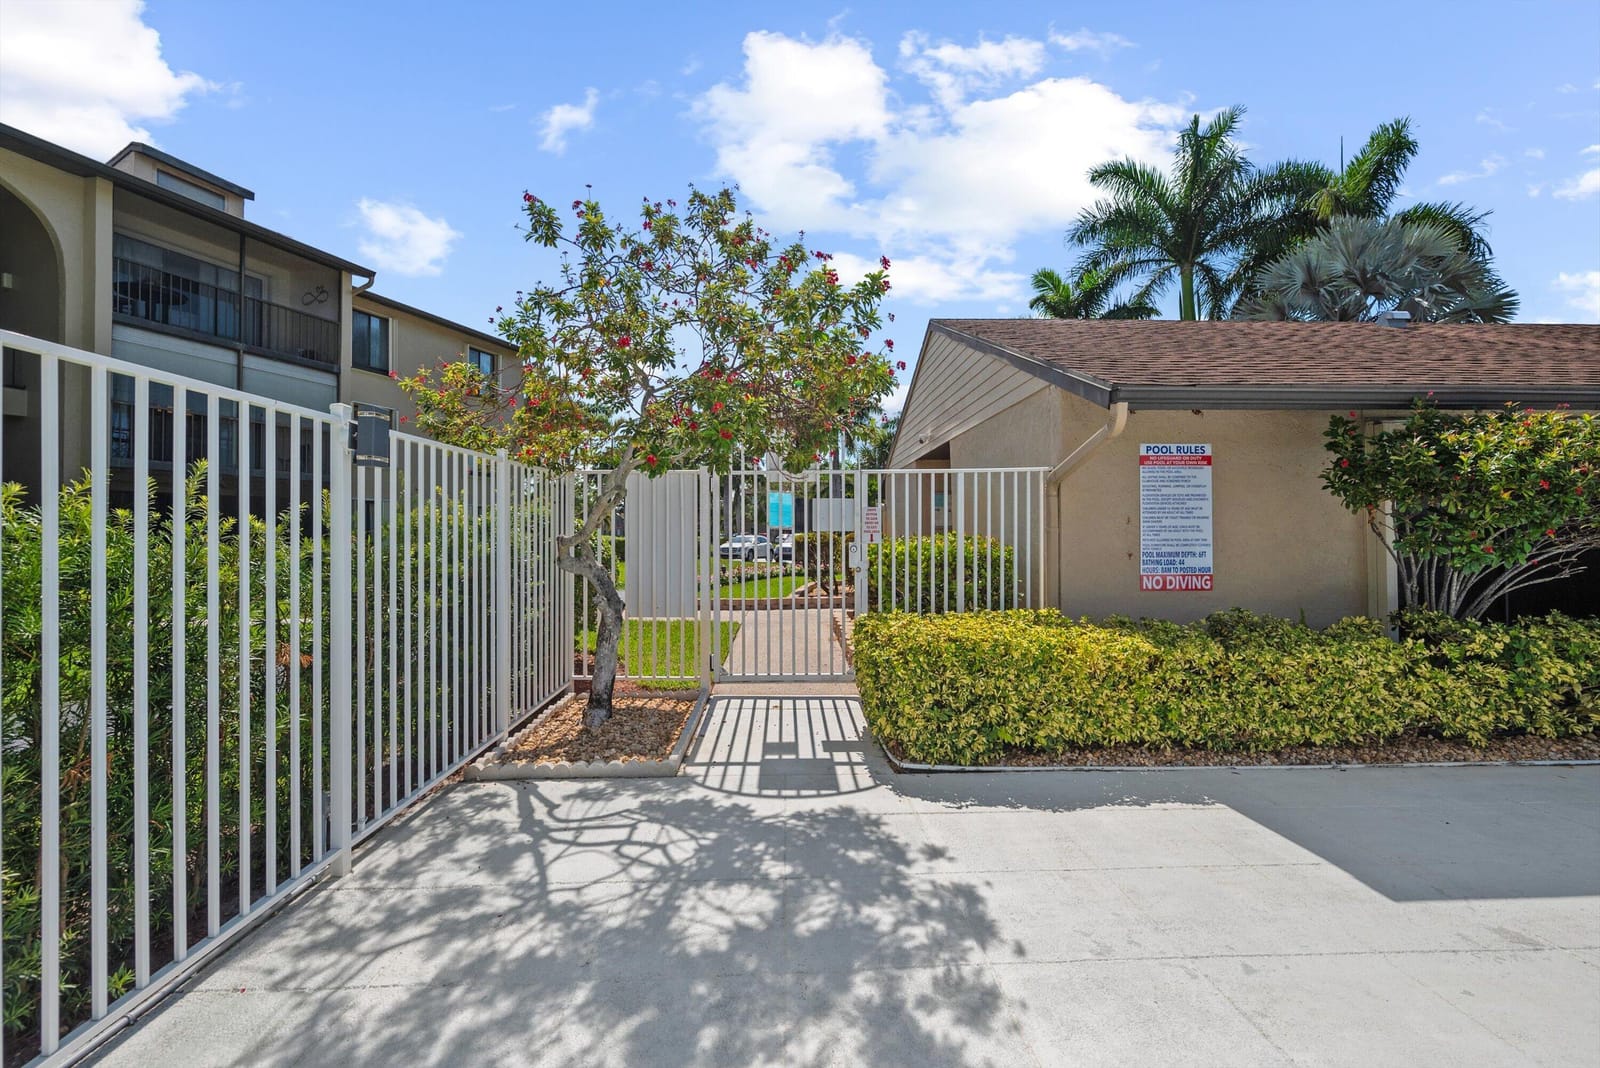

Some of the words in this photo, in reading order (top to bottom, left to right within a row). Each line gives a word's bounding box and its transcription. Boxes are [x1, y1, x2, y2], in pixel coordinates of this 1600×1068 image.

[1146, 446, 1173, 454] POOL
[1176, 446, 1206, 454] RULES
[1142, 576, 1163, 589] NO
[1166, 576, 1211, 589] DIVING
